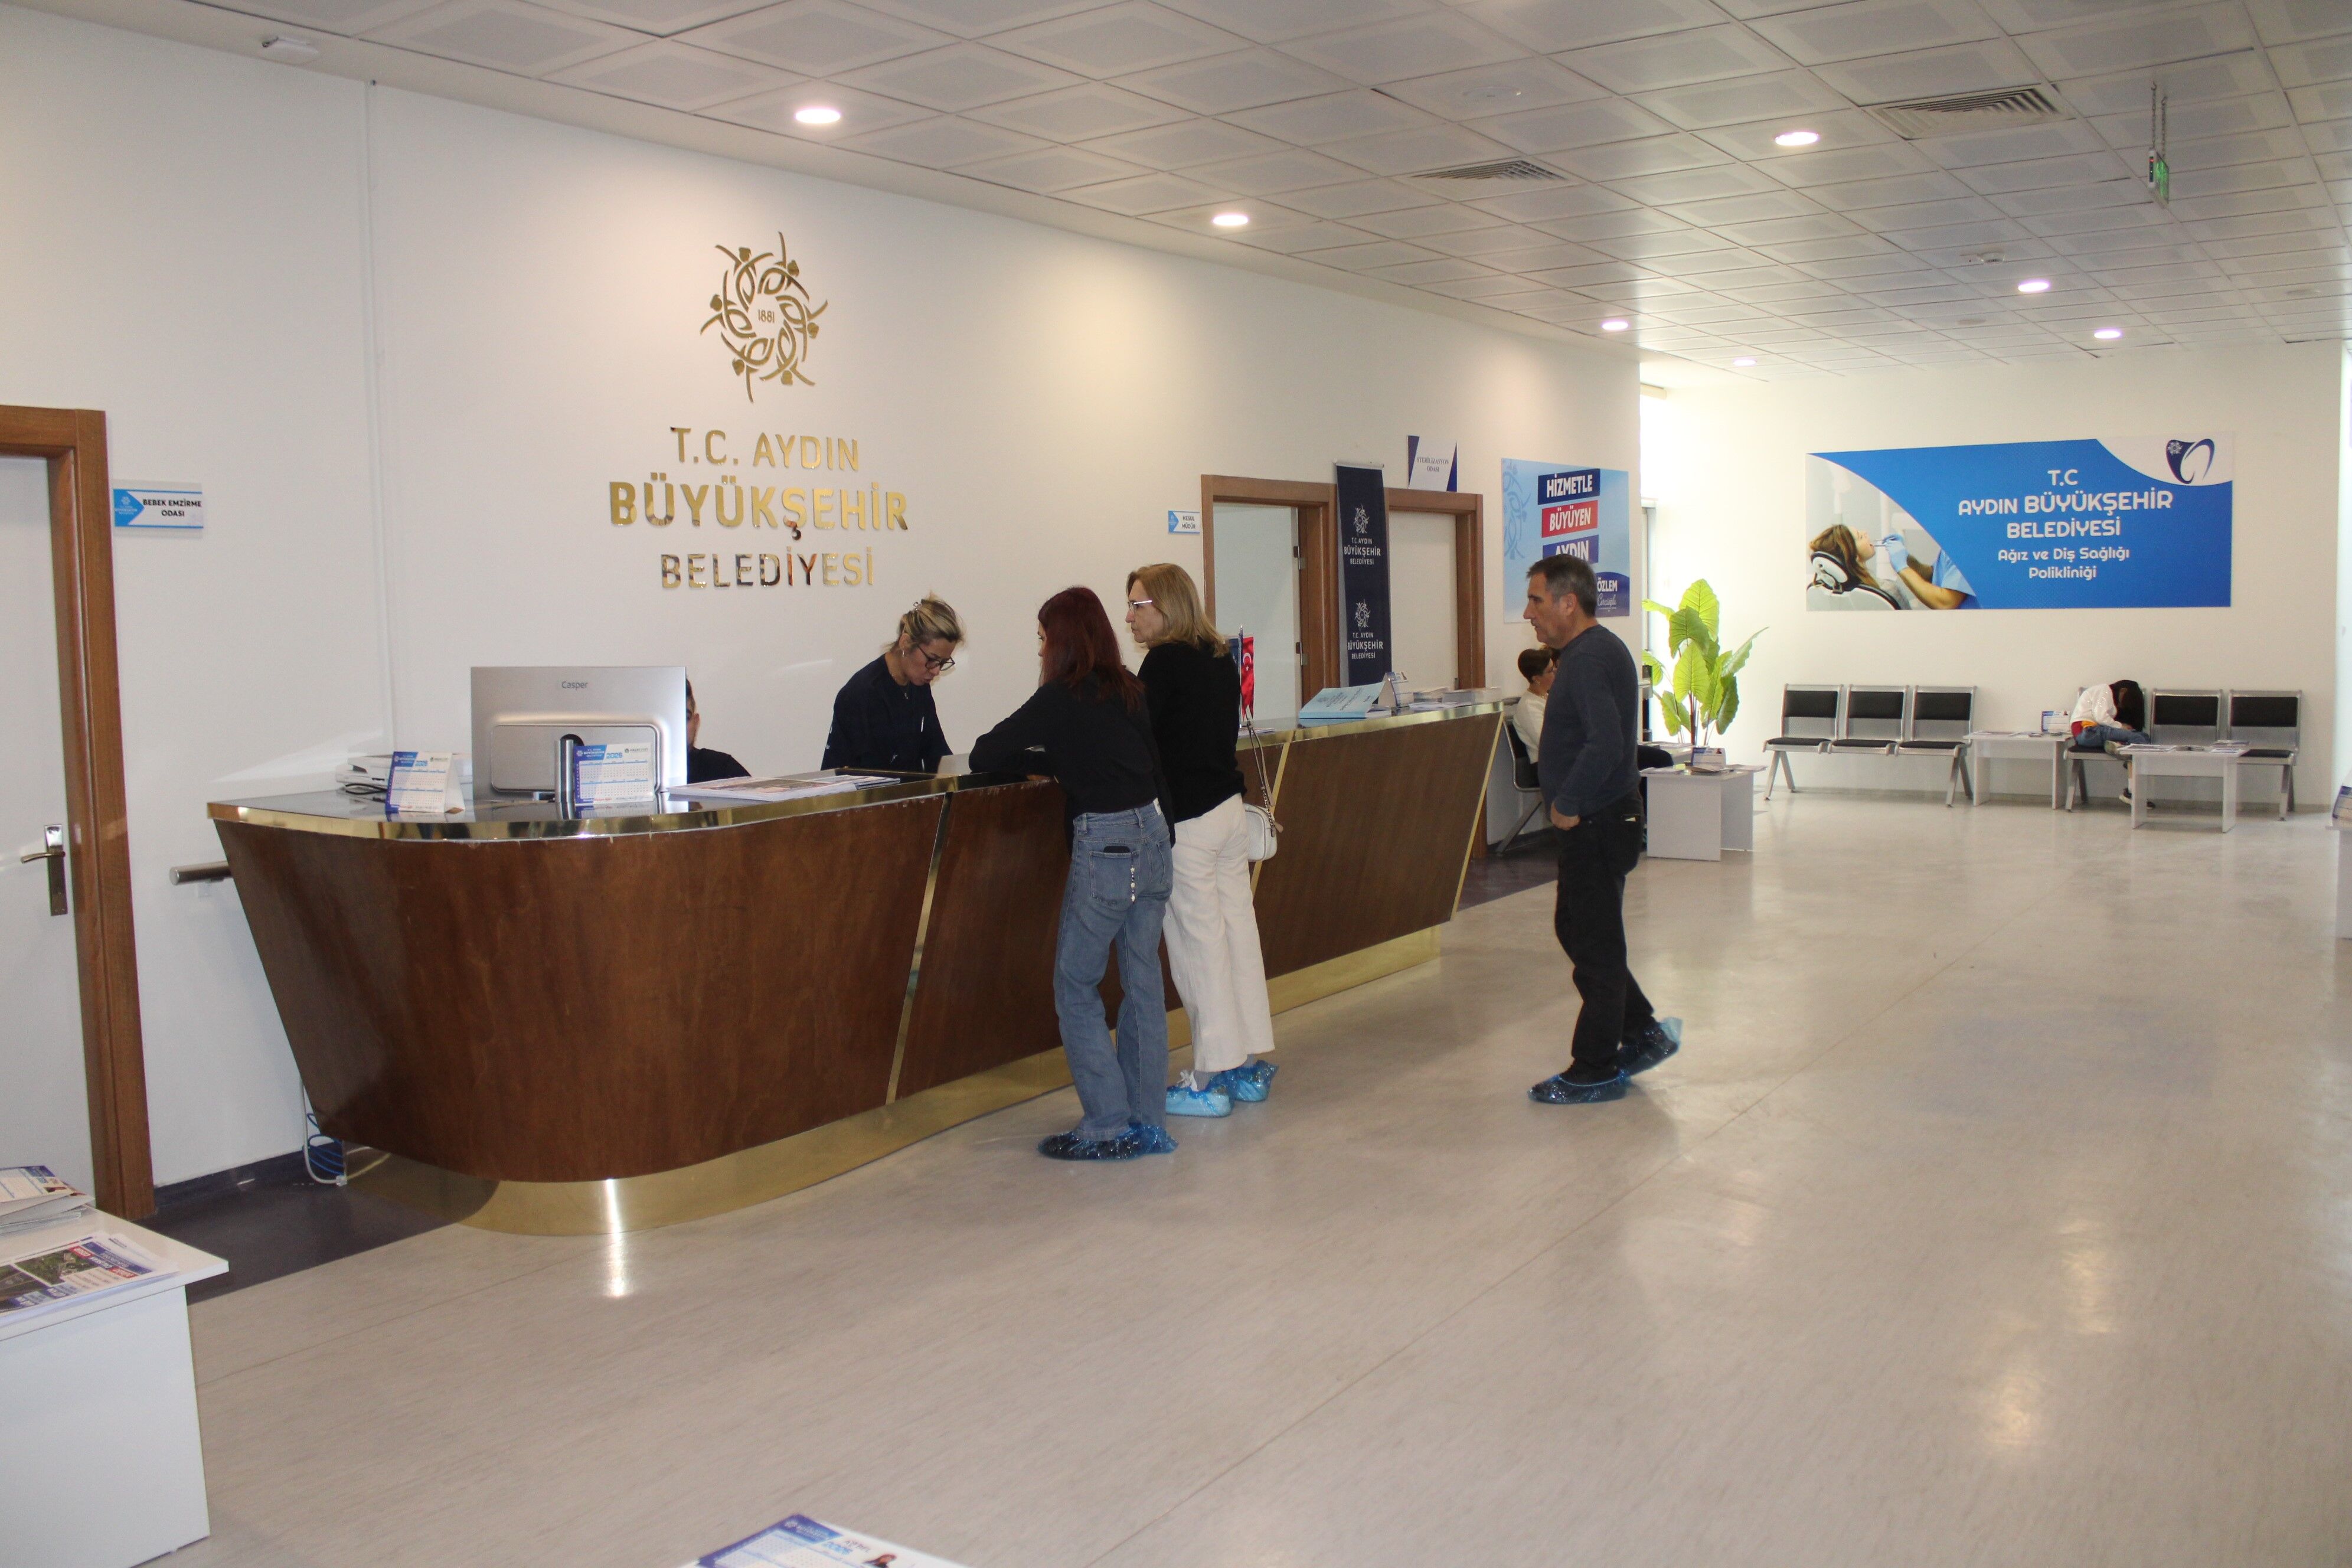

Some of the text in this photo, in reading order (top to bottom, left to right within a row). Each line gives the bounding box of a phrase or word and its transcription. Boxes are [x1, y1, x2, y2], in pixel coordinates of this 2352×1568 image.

[758, 309, 775, 324] 1881
[671, 426, 858, 471] T.C. AYDIN
[1547, 473, 1593, 498] HİZMETLE
[2047, 469, 2078, 486] T.C
[169, 498, 202, 507] EMZİRME
[609, 472, 908, 540] BÜYÜKŞEHİR
[1958, 486, 2173, 515] AYDIN BÜYÜKŞEHİR
[1550, 505, 1591, 531] BÜYÜYEN
[2007, 517, 2121, 538] BELEDİYESİ
[1344, 545, 1381, 557] BÜYÜKŞEHİR
[1998, 547, 2129, 563] Ağız ve Diş Sağlığı
[661, 545, 874, 589] BELEDİYESİ
[2029, 566, 2096, 580] Polikliniği
[1597, 577, 1618, 592] ÖZLEM
[561, 681, 588, 690] Casper
